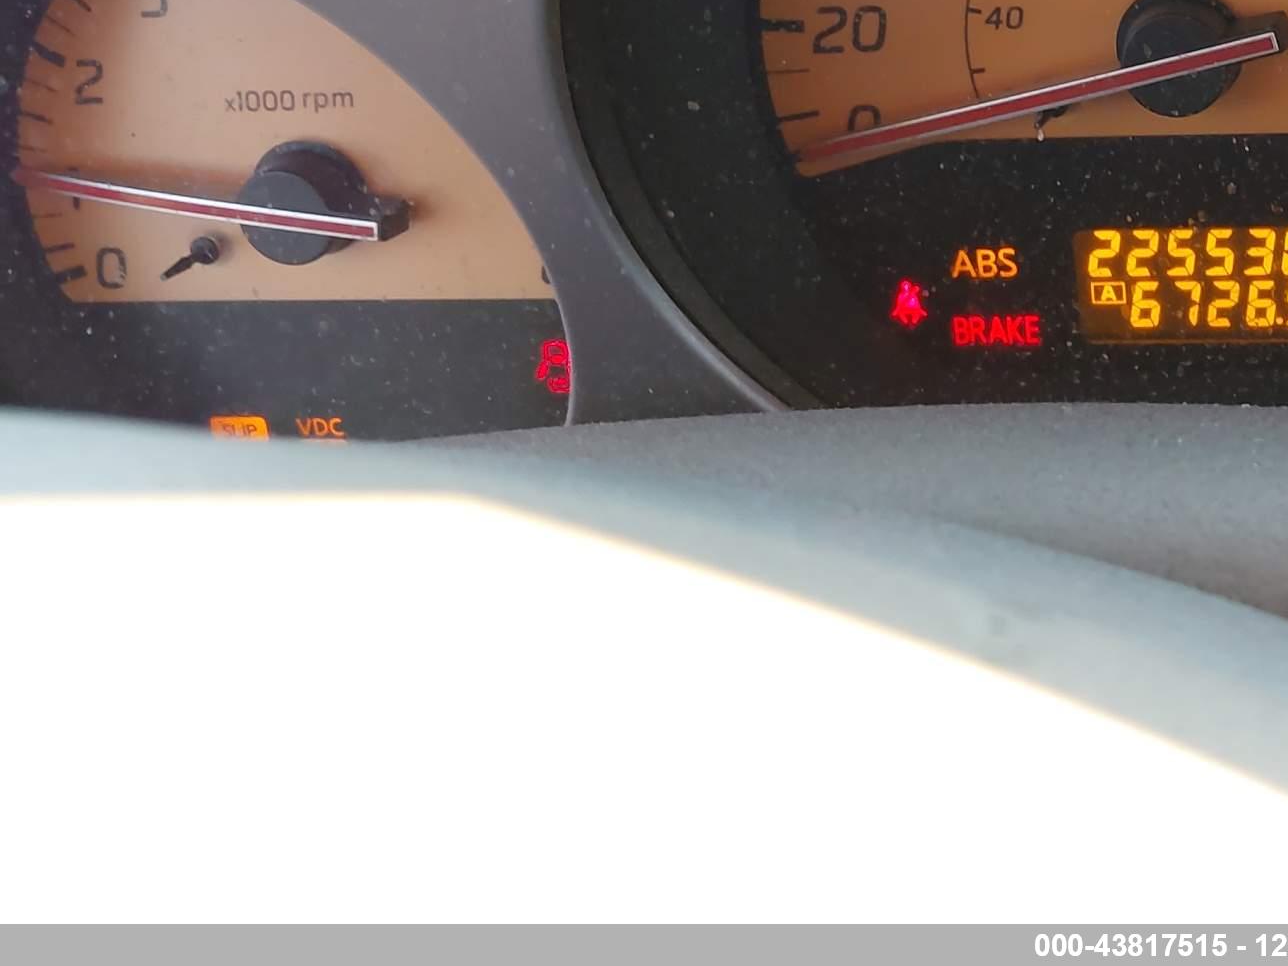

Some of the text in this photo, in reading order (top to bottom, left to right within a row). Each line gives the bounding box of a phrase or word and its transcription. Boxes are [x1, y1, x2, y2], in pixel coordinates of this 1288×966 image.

[811, 5, 888, 55] 20
[984, 5, 1024, 30] 40
[74, 58, 104, 106] 2
[224, 89, 355, 114] x1000 rpm
[95, 246, 128, 290] 0
[951, 247, 1019, 279] ABS
[951, 314, 1041, 346] BRAKE
[295, 416, 345, 437] VDC
